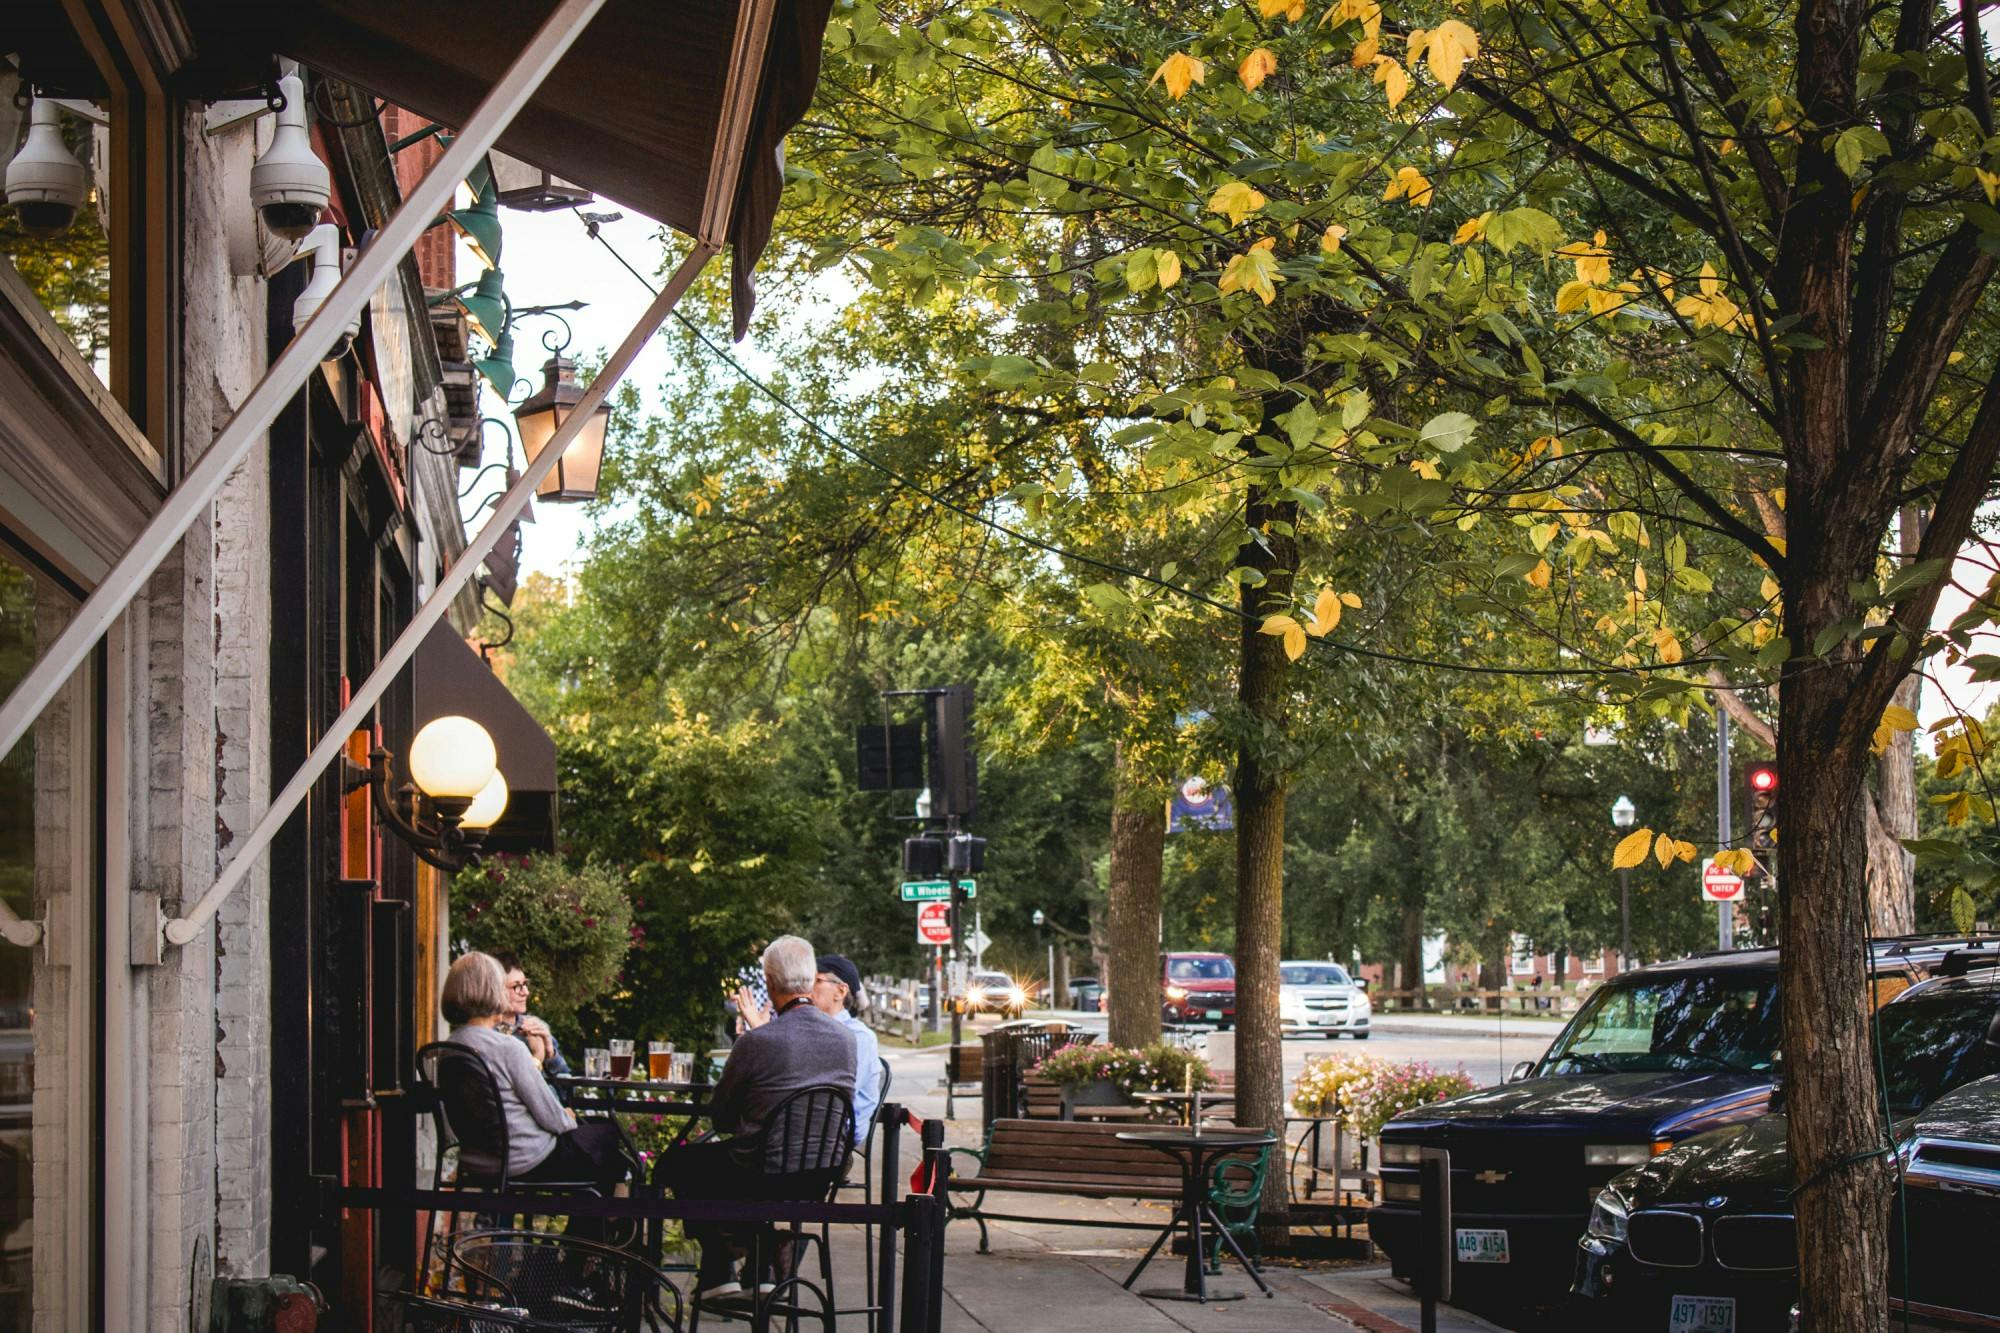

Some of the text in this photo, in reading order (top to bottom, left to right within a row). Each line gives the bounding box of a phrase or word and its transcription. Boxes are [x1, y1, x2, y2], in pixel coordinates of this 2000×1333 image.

[1711, 885, 1735, 893] ENTER
[1459, 1236, 1505, 1252] 448 4154
[1673, 1303, 1733, 1326] 497 1597
